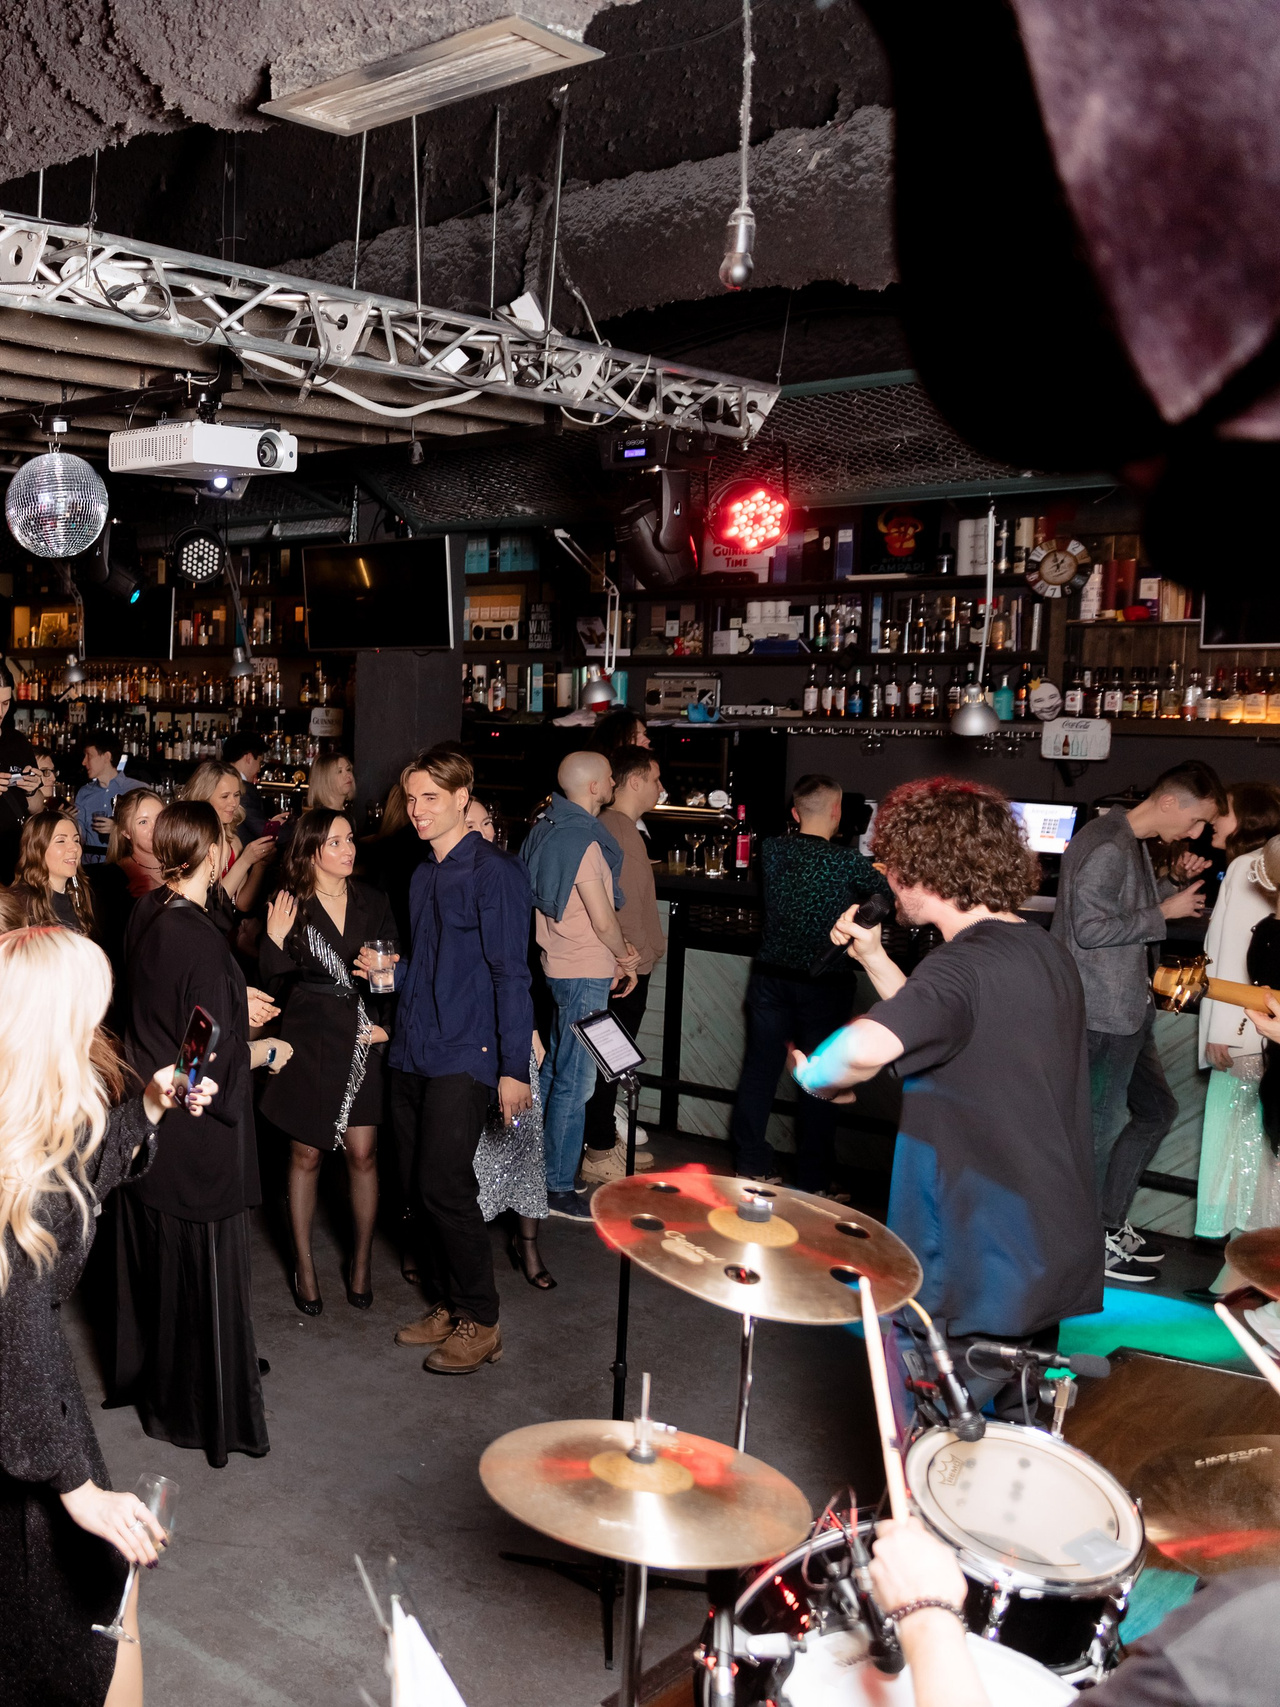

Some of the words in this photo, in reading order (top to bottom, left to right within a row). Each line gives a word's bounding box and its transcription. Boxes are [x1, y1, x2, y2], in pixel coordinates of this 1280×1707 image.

[1071, 541, 1081, 552] 2
[725, 557, 748, 567] TIME
[869, 561, 926, 573] CAMPARI
[1050, 588, 1057, 597] 7
[1064, 585, 1072, 595] 6
[528, 620, 553, 633] WINE
[946, 1459, 961, 1483] REMO
